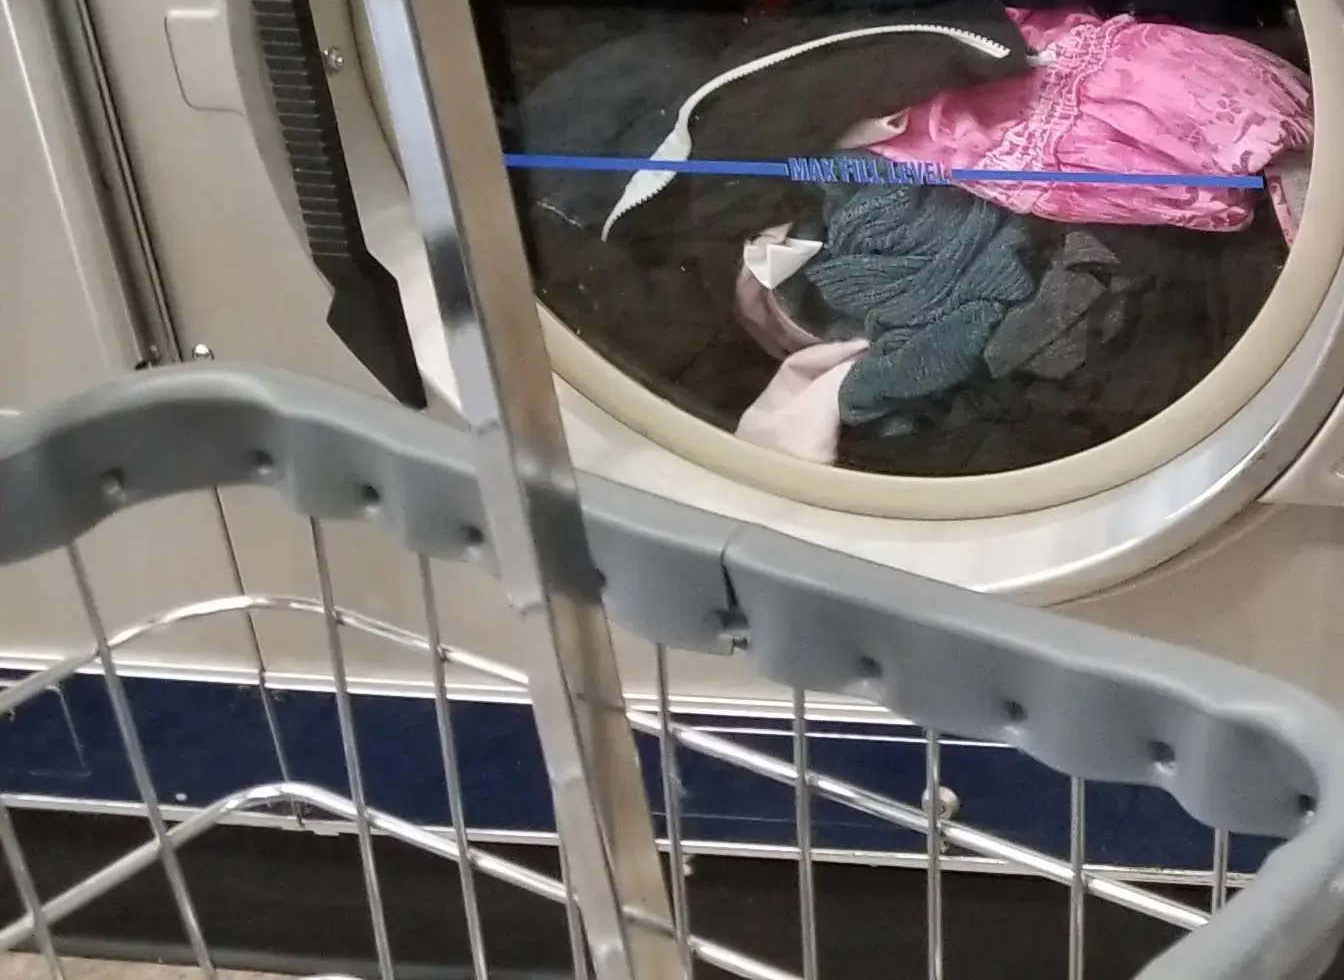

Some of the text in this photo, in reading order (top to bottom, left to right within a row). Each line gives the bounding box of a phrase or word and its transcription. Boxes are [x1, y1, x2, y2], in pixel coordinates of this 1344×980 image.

[787, 157, 951, 185] MAX FILL LEVEL
